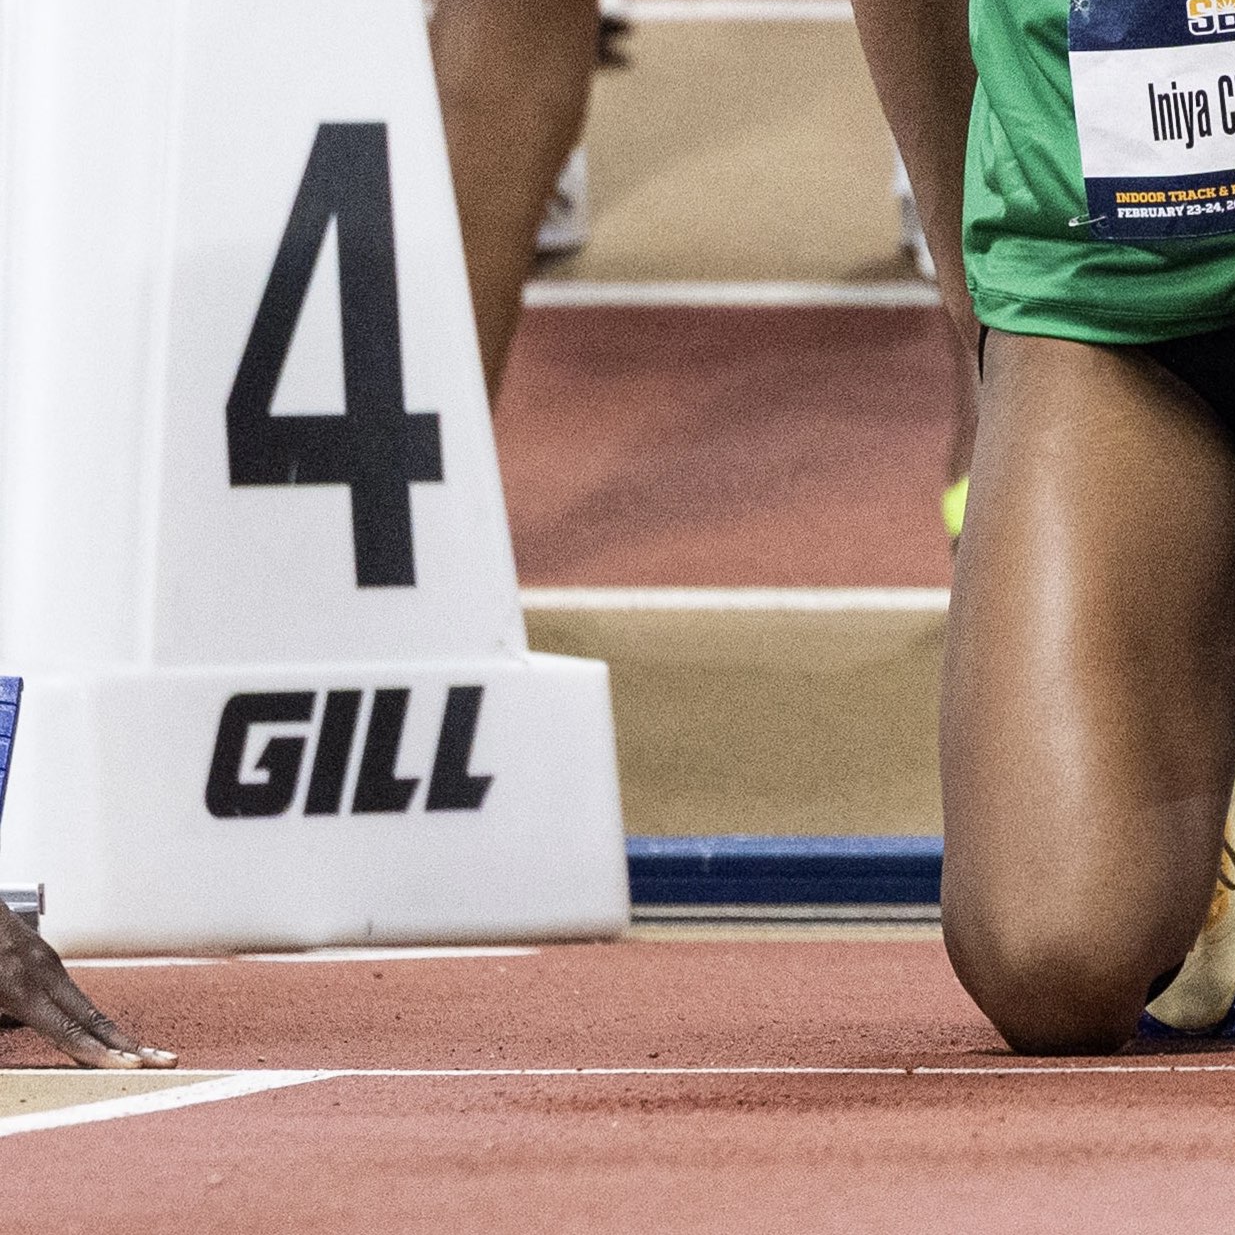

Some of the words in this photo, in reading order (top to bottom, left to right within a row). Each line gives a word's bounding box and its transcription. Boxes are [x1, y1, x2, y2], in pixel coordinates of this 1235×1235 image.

[1148, 81, 1212, 149] Iniya
[1115, 192, 1166, 204] INDOOR
[1168, 187, 1217, 203] TRACK
[1219, 186, 1229, 197] &
[1117, 206, 1184, 218] FEBRUARY
[1186, 202, 1225, 216] 23-24,
[226, 122, 443, 587] 4
[205, 686, 494, 818] GILL
